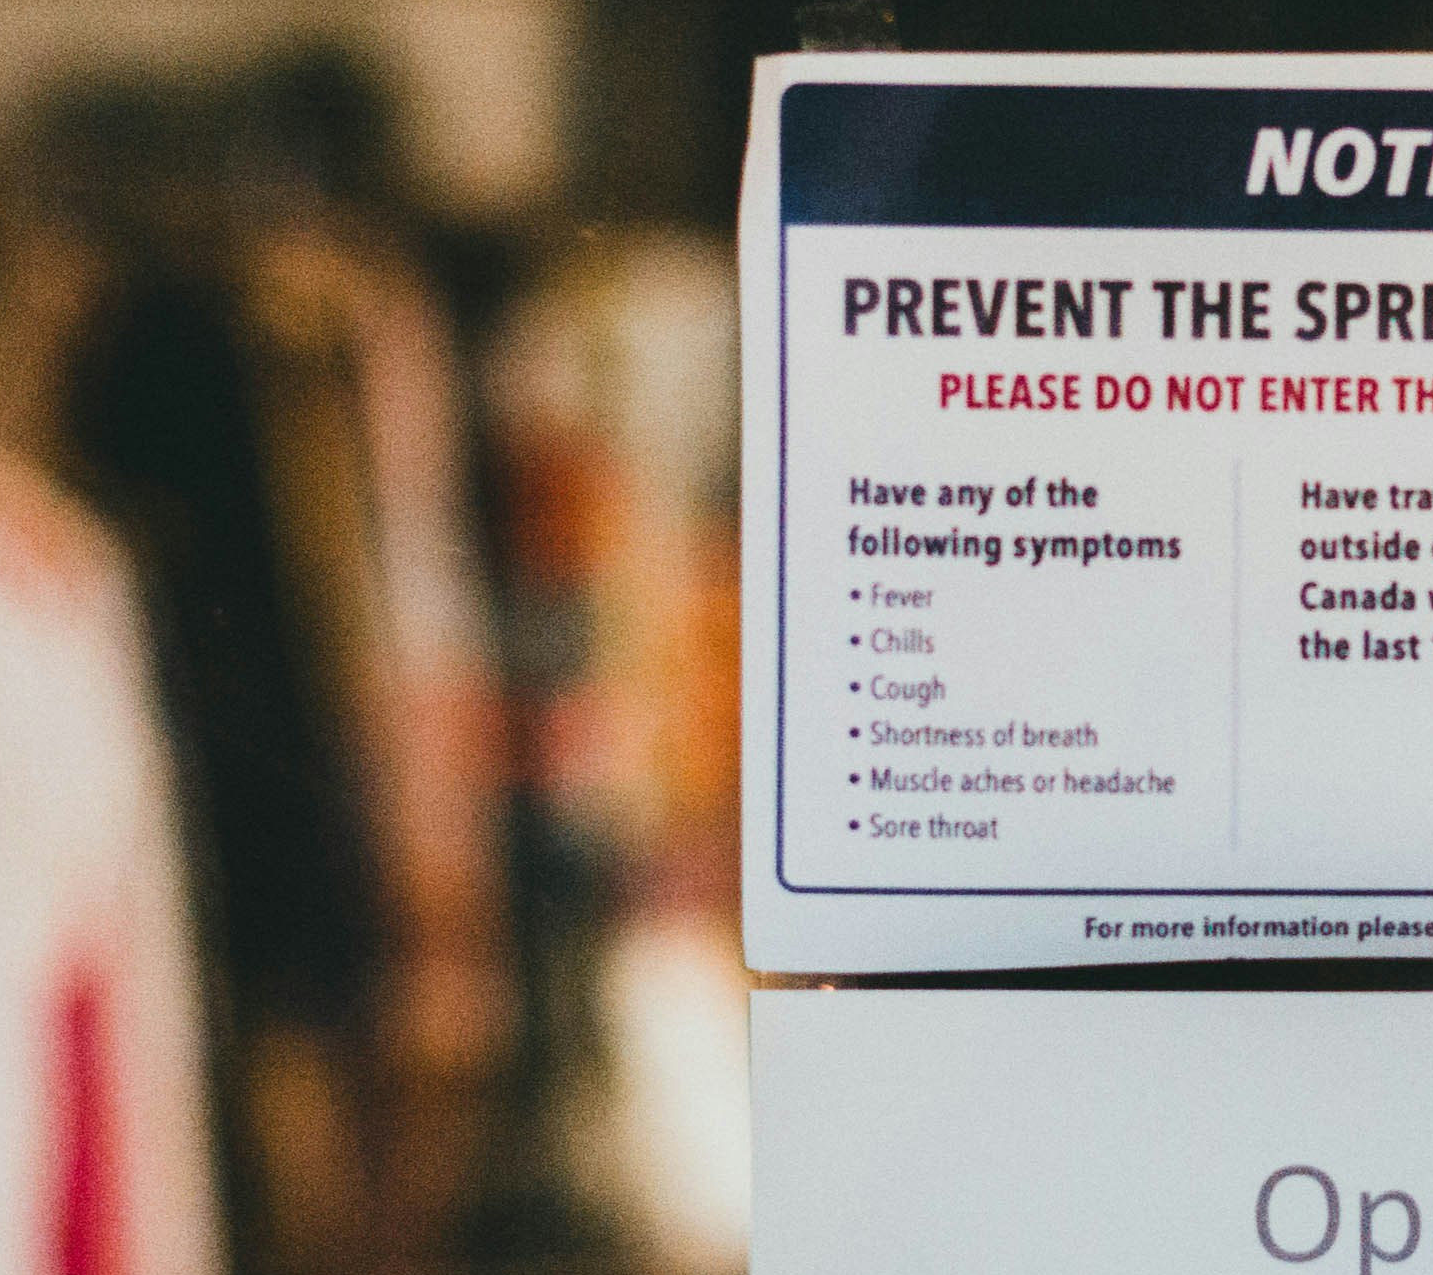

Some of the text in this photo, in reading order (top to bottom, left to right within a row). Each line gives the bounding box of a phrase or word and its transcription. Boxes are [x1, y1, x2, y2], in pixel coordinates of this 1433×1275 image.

[843, 277, 1134, 339] PREVENT
[1151, 279, 1272, 341] THE
[939, 372, 1081, 411] PLEASE
[1095, 374, 1153, 413] DO
[1166, 374, 1246, 413] NOT
[1259, 375, 1380, 414] ENTER
[849, 475, 1099, 517] Have any of the
[1300, 481, 1379, 511] Have
[847, 524, 1182, 568] following symptoms
[1299, 530, 1421, 562] outside
[870, 581, 934, 609] Fever
[1299, 580, 1417, 612] Canada
[869, 626, 936, 656] Chills
[1298, 629, 1351, 662] the
[1362, 629, 1421, 662] last
[869, 674, 947, 711] Cough
[869, 720, 1099, 749] Shortness of breath
[869, 766, 1176, 795] Muscle aches or headache
[868, 812, 999, 840] Sore throat
[1084, 916, 1124, 940] For
[1130, 921, 1196, 939] more
[1202, 914, 1350, 938] information
